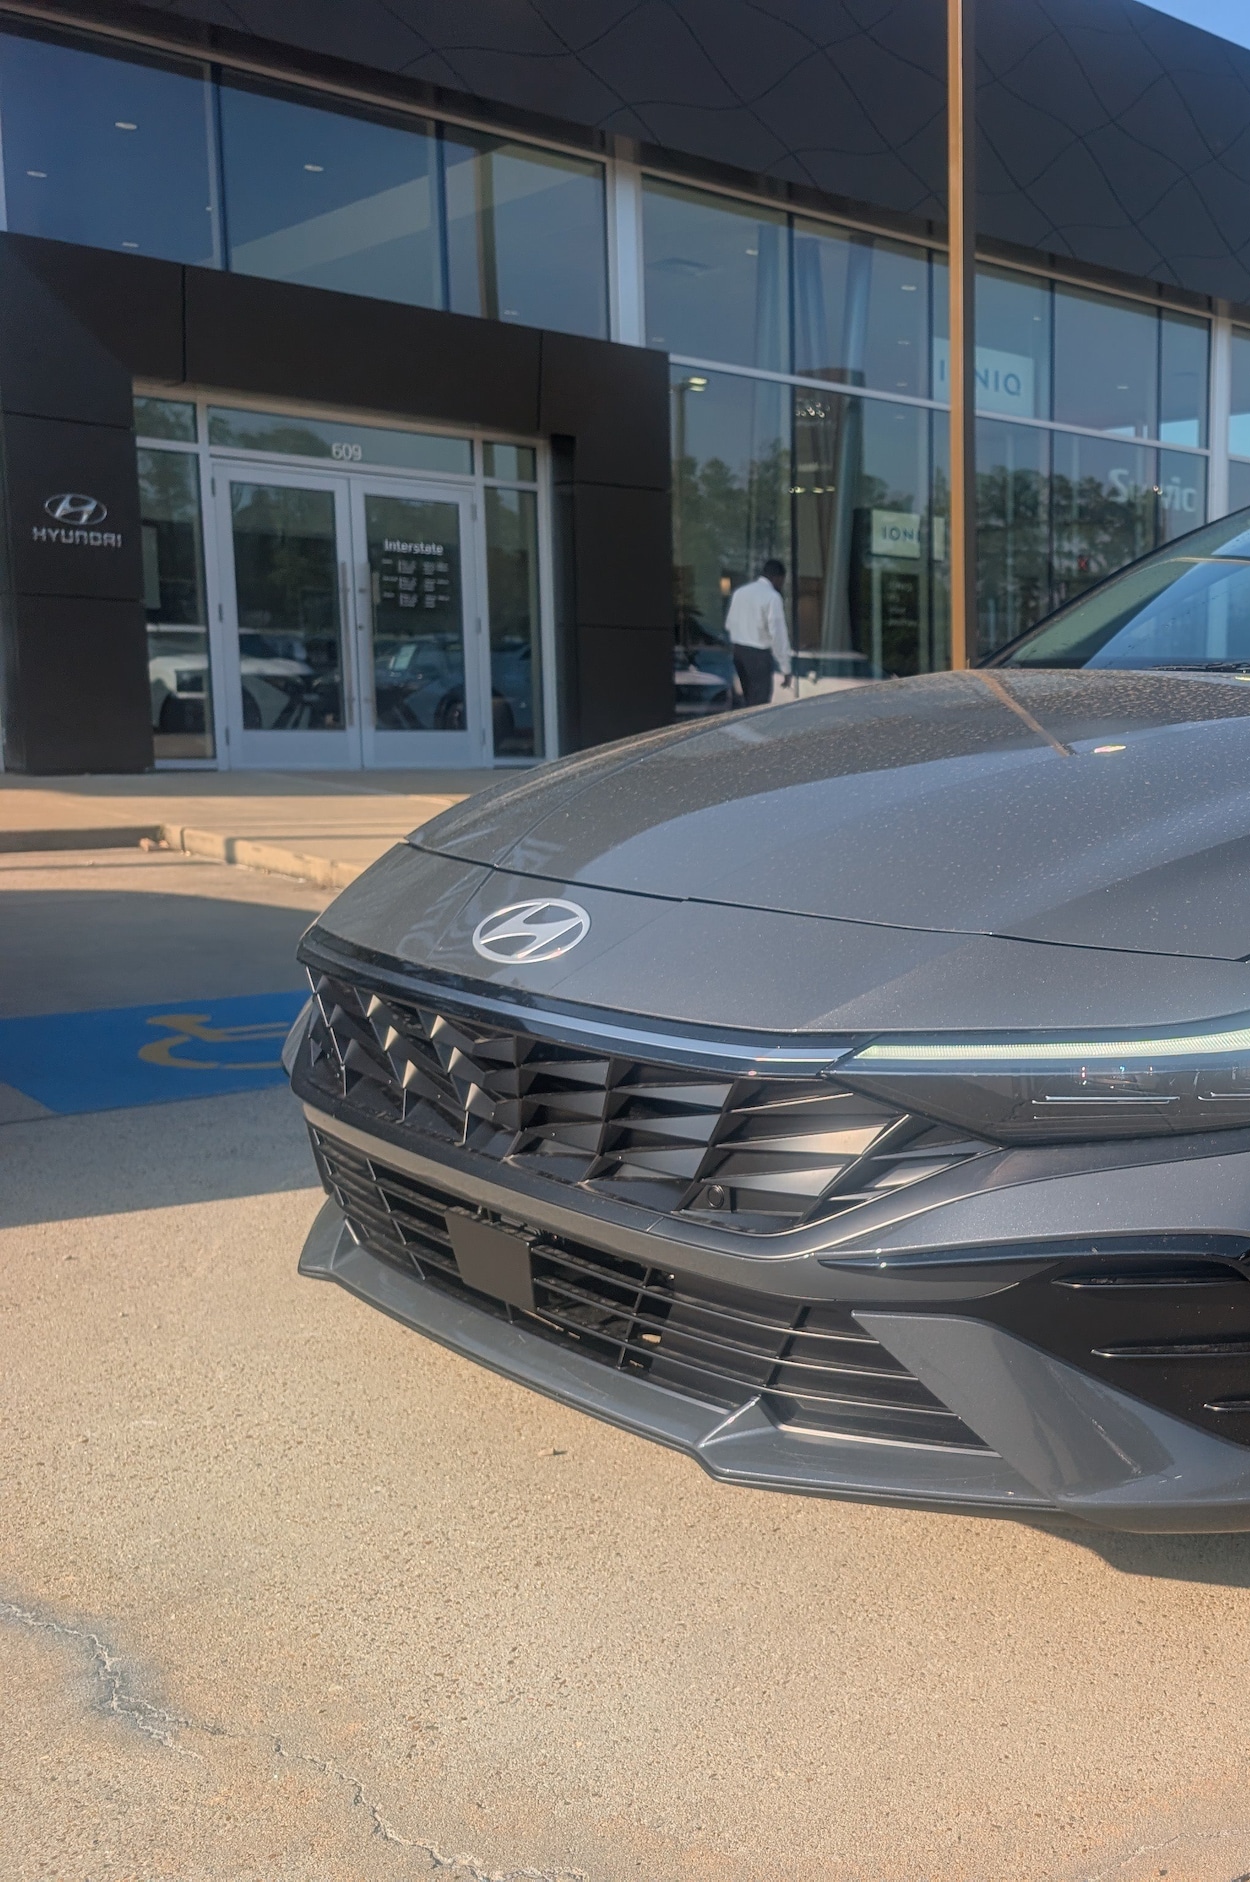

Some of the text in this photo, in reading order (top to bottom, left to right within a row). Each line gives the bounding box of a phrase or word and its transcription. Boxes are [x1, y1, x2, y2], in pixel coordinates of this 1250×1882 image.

[940, 359, 1021, 396] INIQ
[332, 442, 362, 461] 609
[32, 525, 122, 548] HYUNDAI
[384, 538, 444, 556] Interstate
